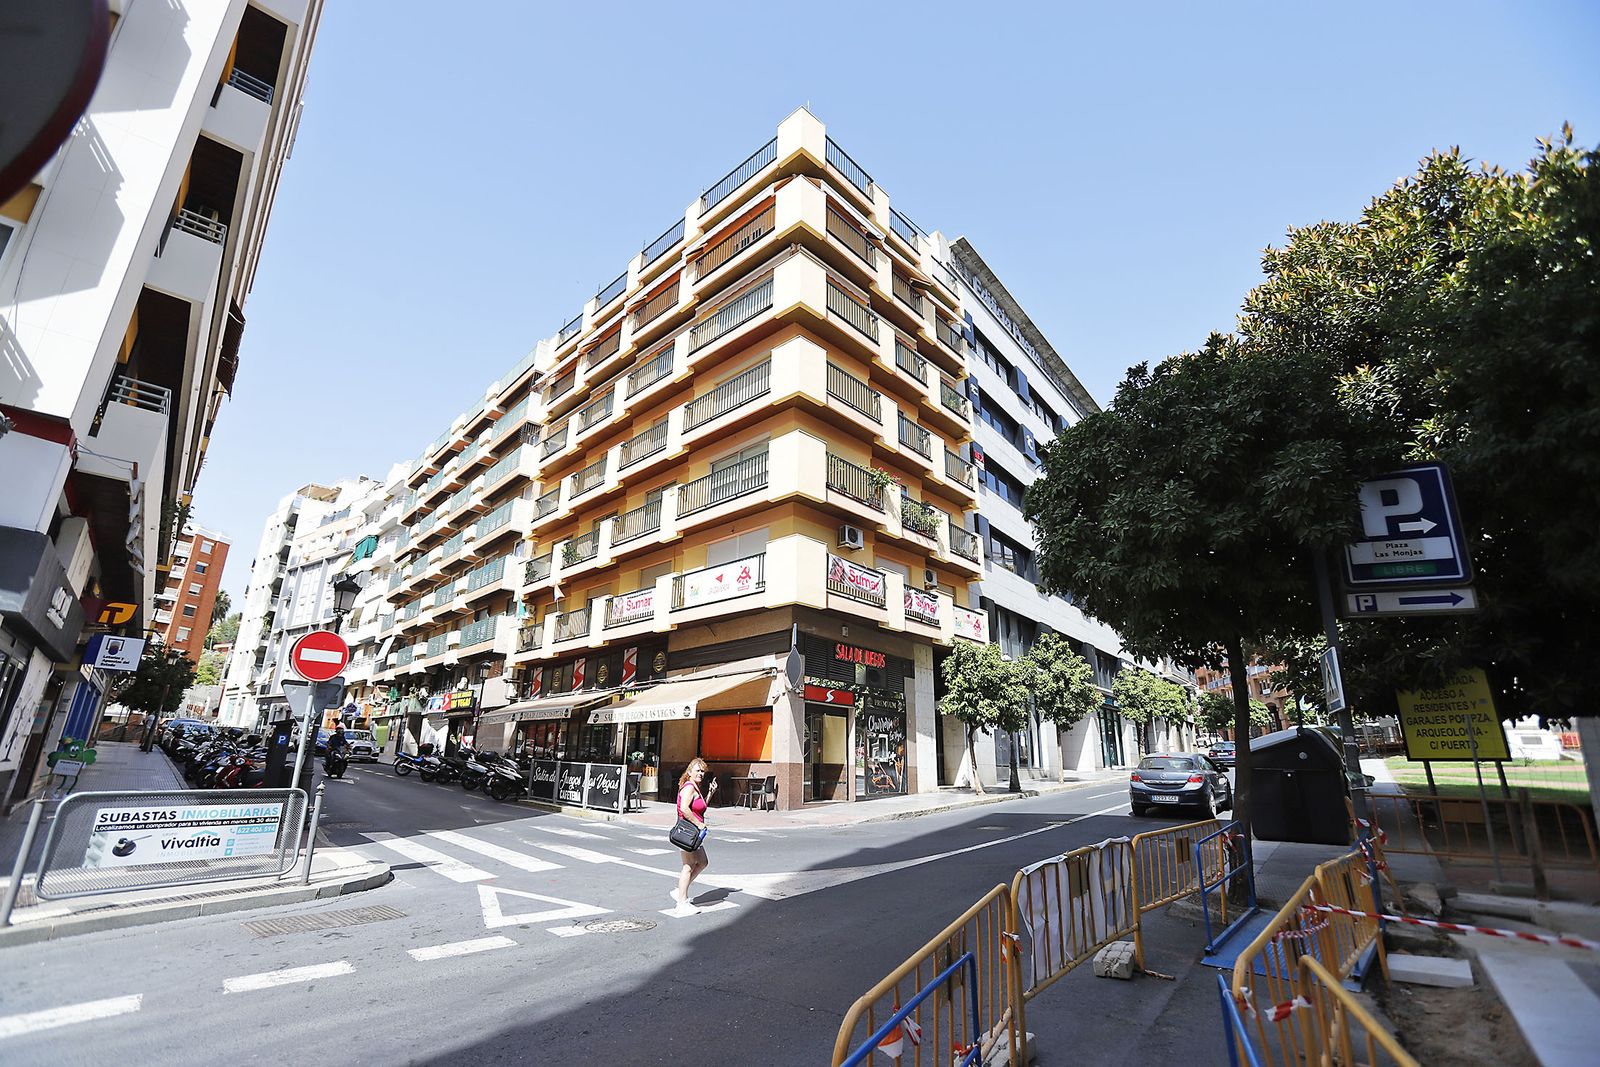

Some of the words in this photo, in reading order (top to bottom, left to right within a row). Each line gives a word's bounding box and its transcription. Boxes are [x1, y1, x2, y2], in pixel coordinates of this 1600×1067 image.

[1358, 477, 1424, 537] P
[1393, 549, 1424, 558] Monjas
[1383, 564, 1425, 575] LIBRE
[835, 643, 854, 661] SALA
[854, 648, 863, 664] DE
[1420, 689, 1457, 701] ACCESO
[1459, 689, 1466, 698] A
[1413, 701, 1470, 713] RESIDENTES
[1470, 700, 1477, 709] Y
[1406, 715, 1449, 726] GARAJES
[559, 769, 582, 791] Juegos
[596, 772, 620, 795] Vegas
[99, 810, 177, 823] SUBASTAS
[181, 806, 279, 820] INMOBILIARIAS
[95, 823, 135, 832] Localizamos
